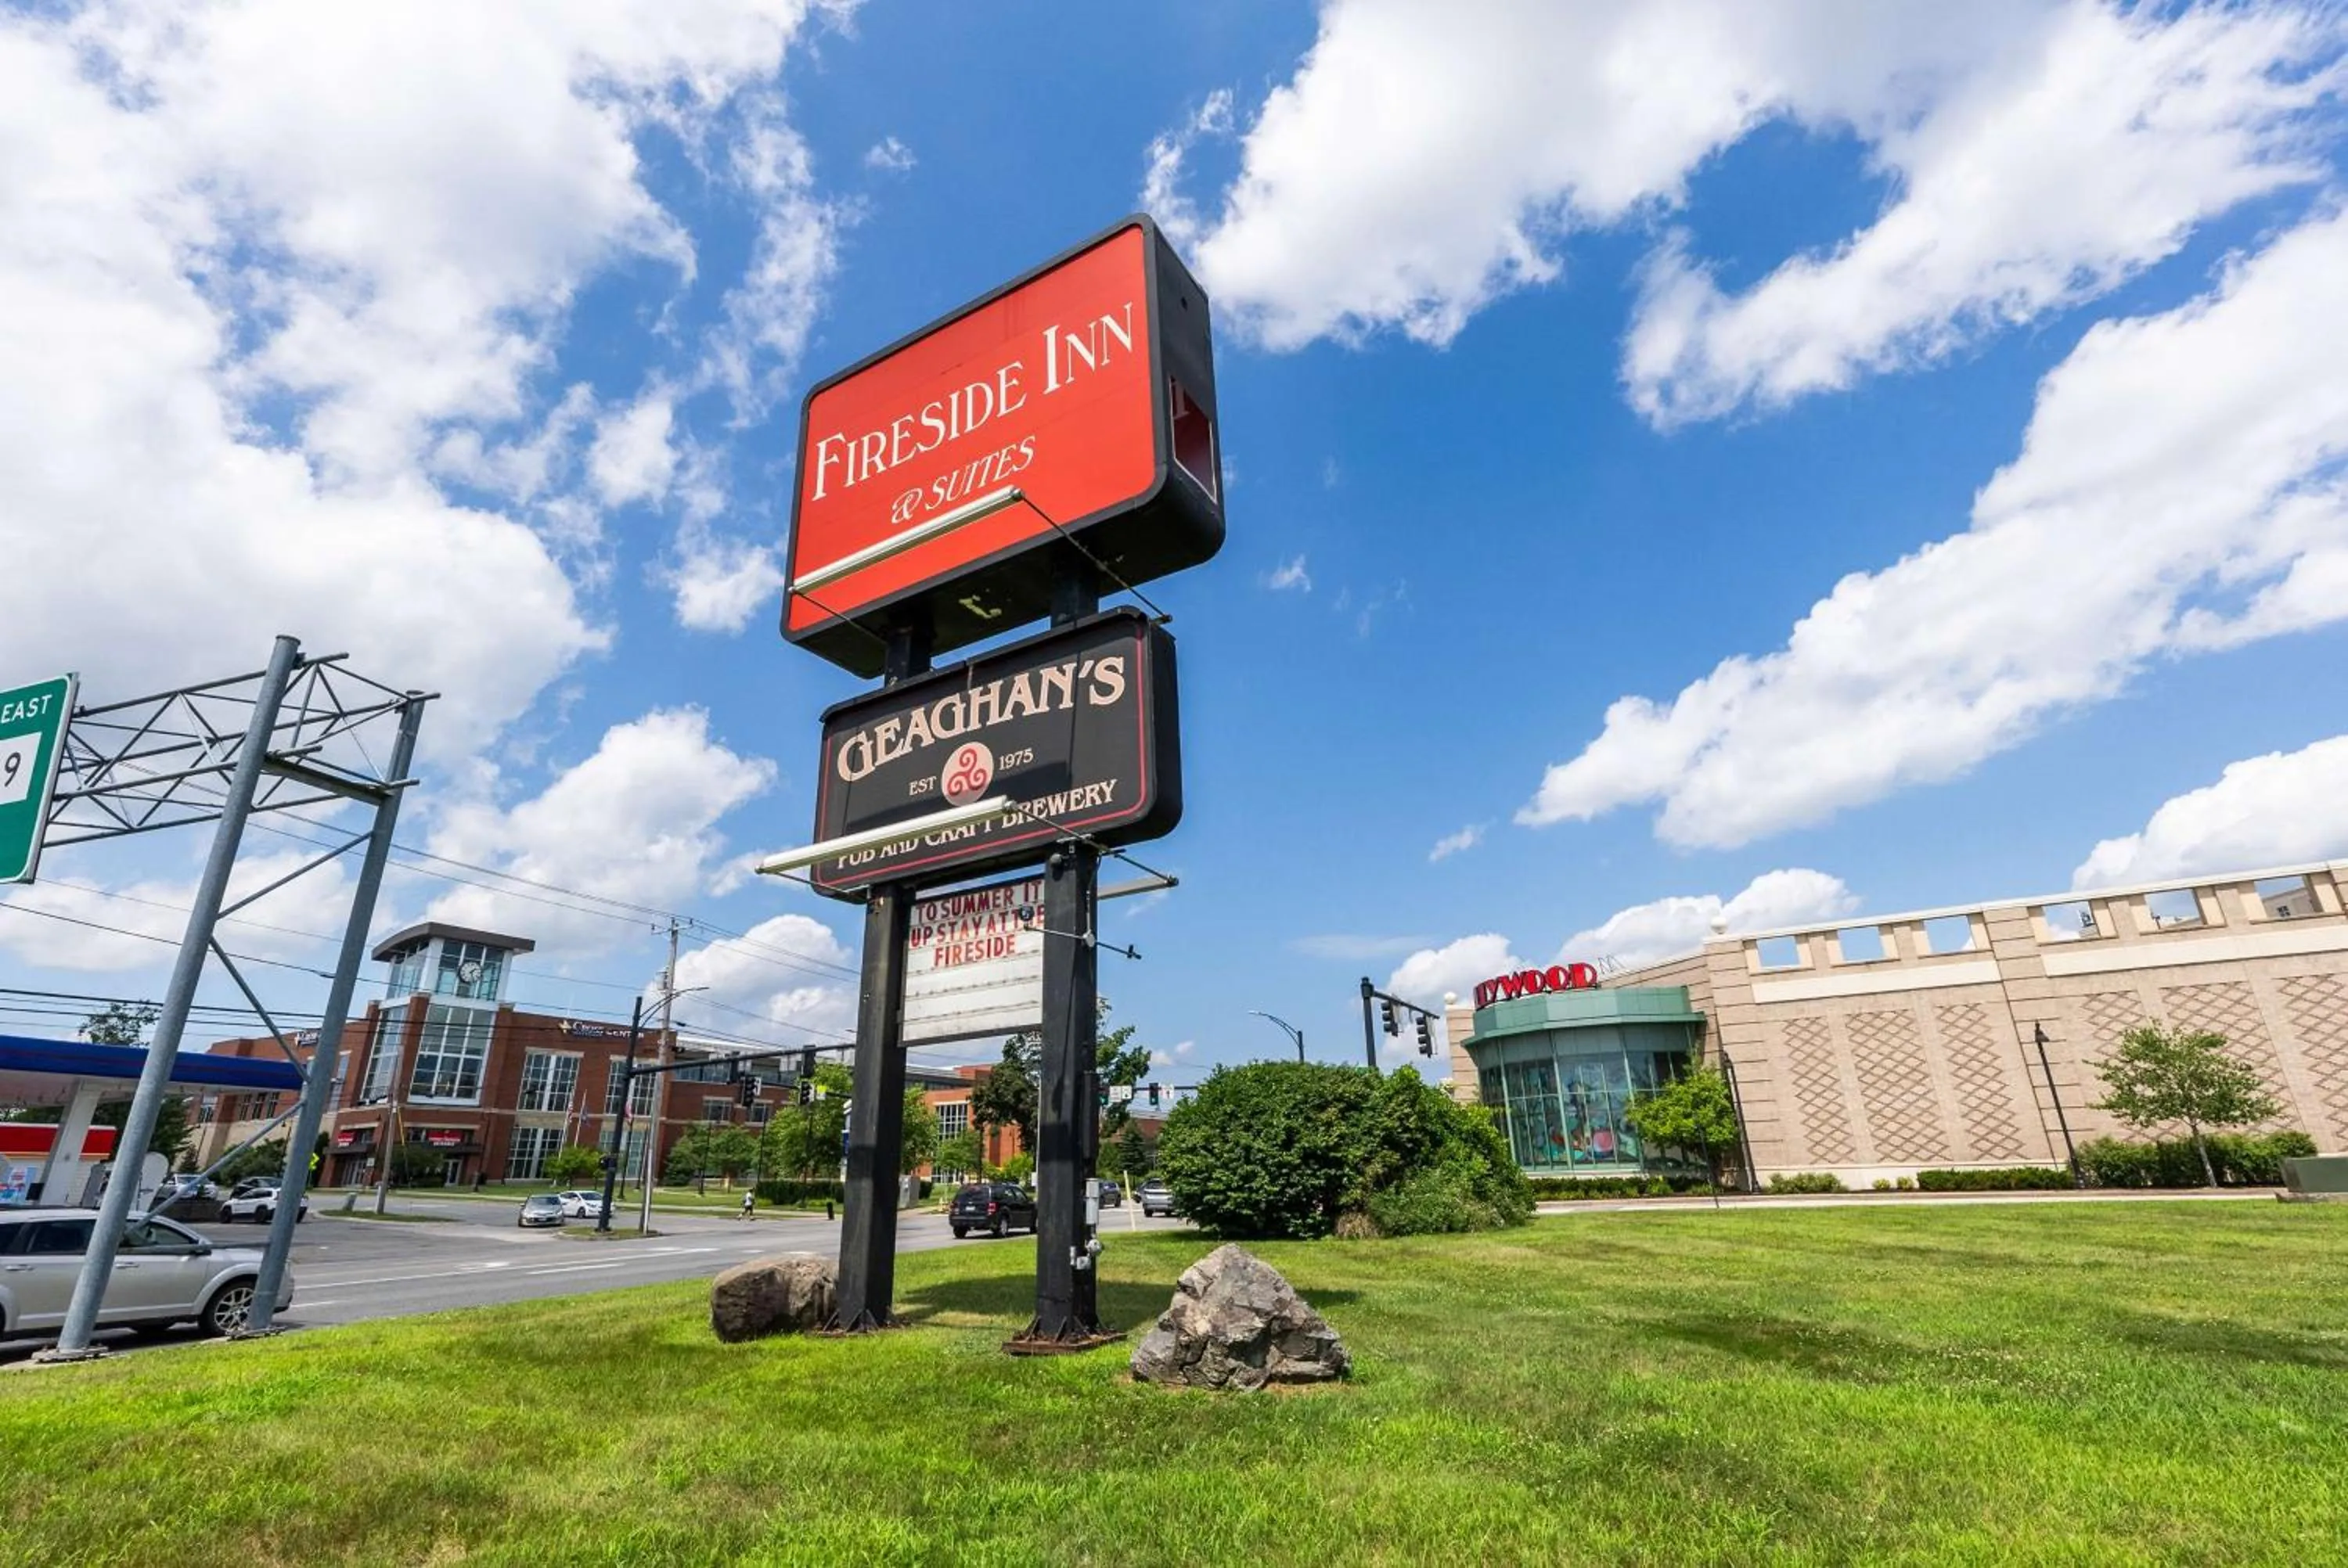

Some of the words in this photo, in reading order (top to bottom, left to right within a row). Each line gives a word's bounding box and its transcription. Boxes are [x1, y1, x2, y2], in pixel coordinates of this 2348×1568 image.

[812, 361, 1028, 502] FIRESIDE
[1042, 301, 1133, 395] INN
[924, 435, 1035, 512] SUITES
[1, 694, 52, 724] EAST
[837, 656, 1125, 782] GEAGHAN'S
[5, 751, 21, 787] 9
[909, 775, 937, 796] EST
[999, 747, 1034, 771] 1975
[917, 901, 937, 925] TO
[941, 887, 1014, 918] SUMMER
[1024, 881, 1042, 902] IT
[911, 926, 933, 947] UP
[937, 917, 982, 942] STAY
[987, 912, 1009, 935] AT
[1011, 904, 1044, 929] TE
[935, 934, 1015, 967] FIRESIDE
